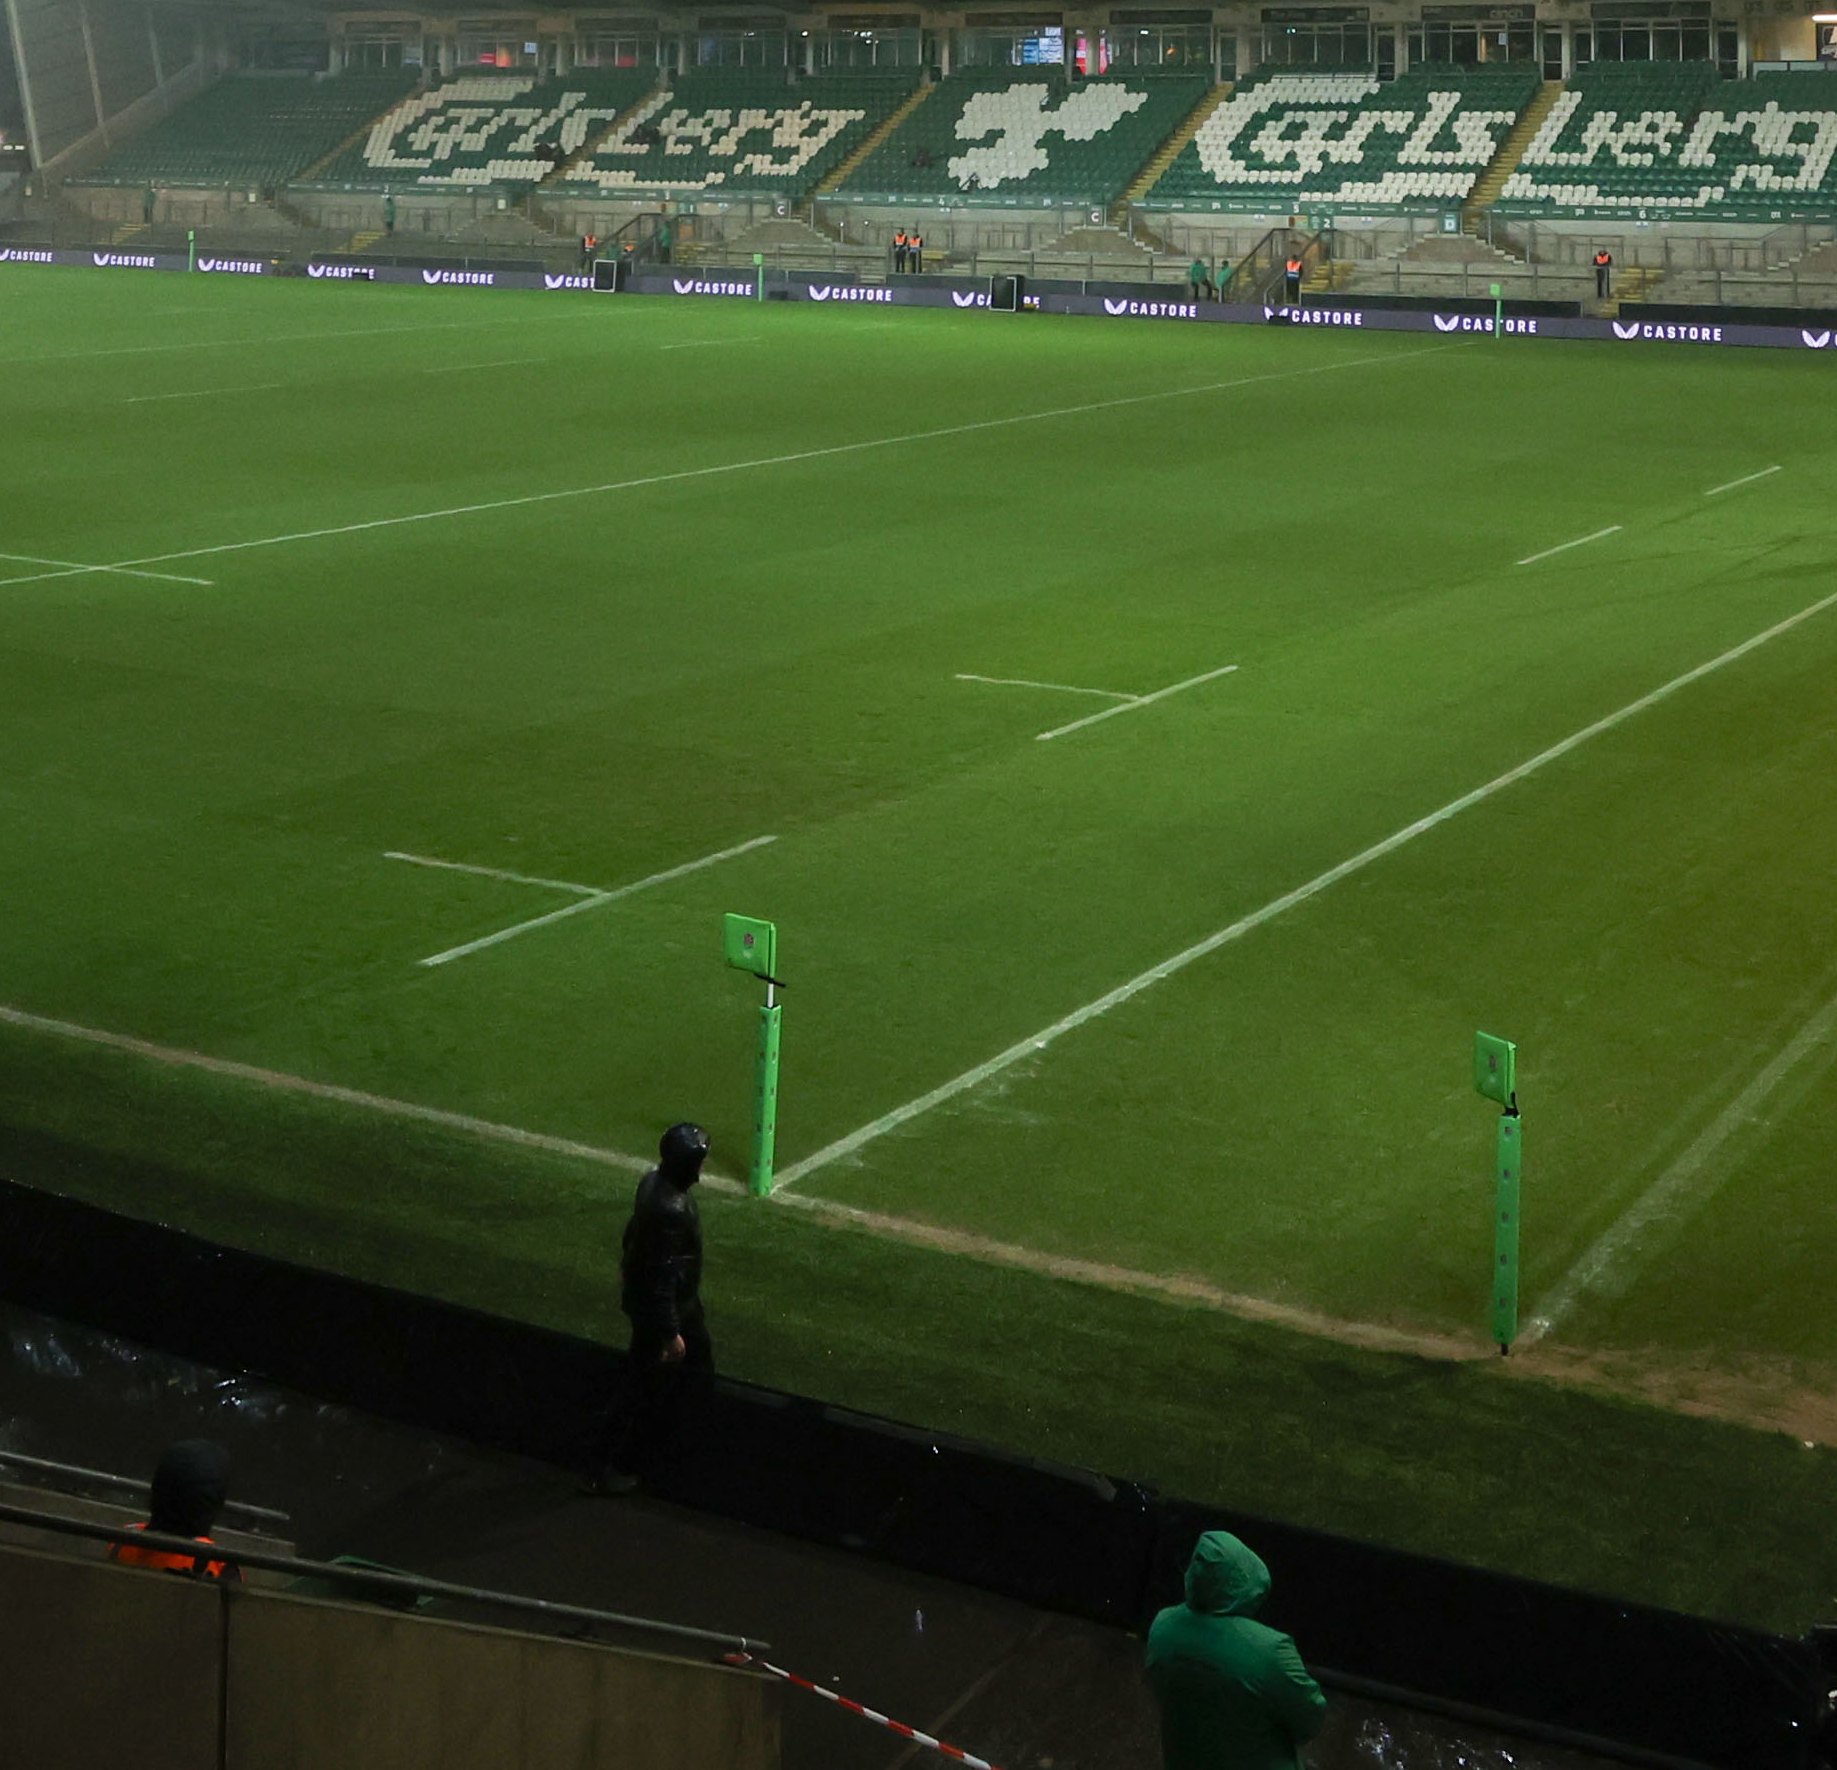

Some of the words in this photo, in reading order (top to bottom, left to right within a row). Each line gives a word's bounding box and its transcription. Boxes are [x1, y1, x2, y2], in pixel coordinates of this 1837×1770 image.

[9, 250, 53, 262] CASTORE
[110, 256, 155, 267] CASTORE
[215, 261, 262, 273] CASTORE
[442, 272, 494, 285] CASTORE
[694, 281, 752, 296] CASTORE
[831, 287, 892, 302] CASTORE
[1129, 302, 1197, 318] CASTORE
[1291, 310, 1363, 326] CASTORE
[1643, 325, 1723, 342] CASTORE
